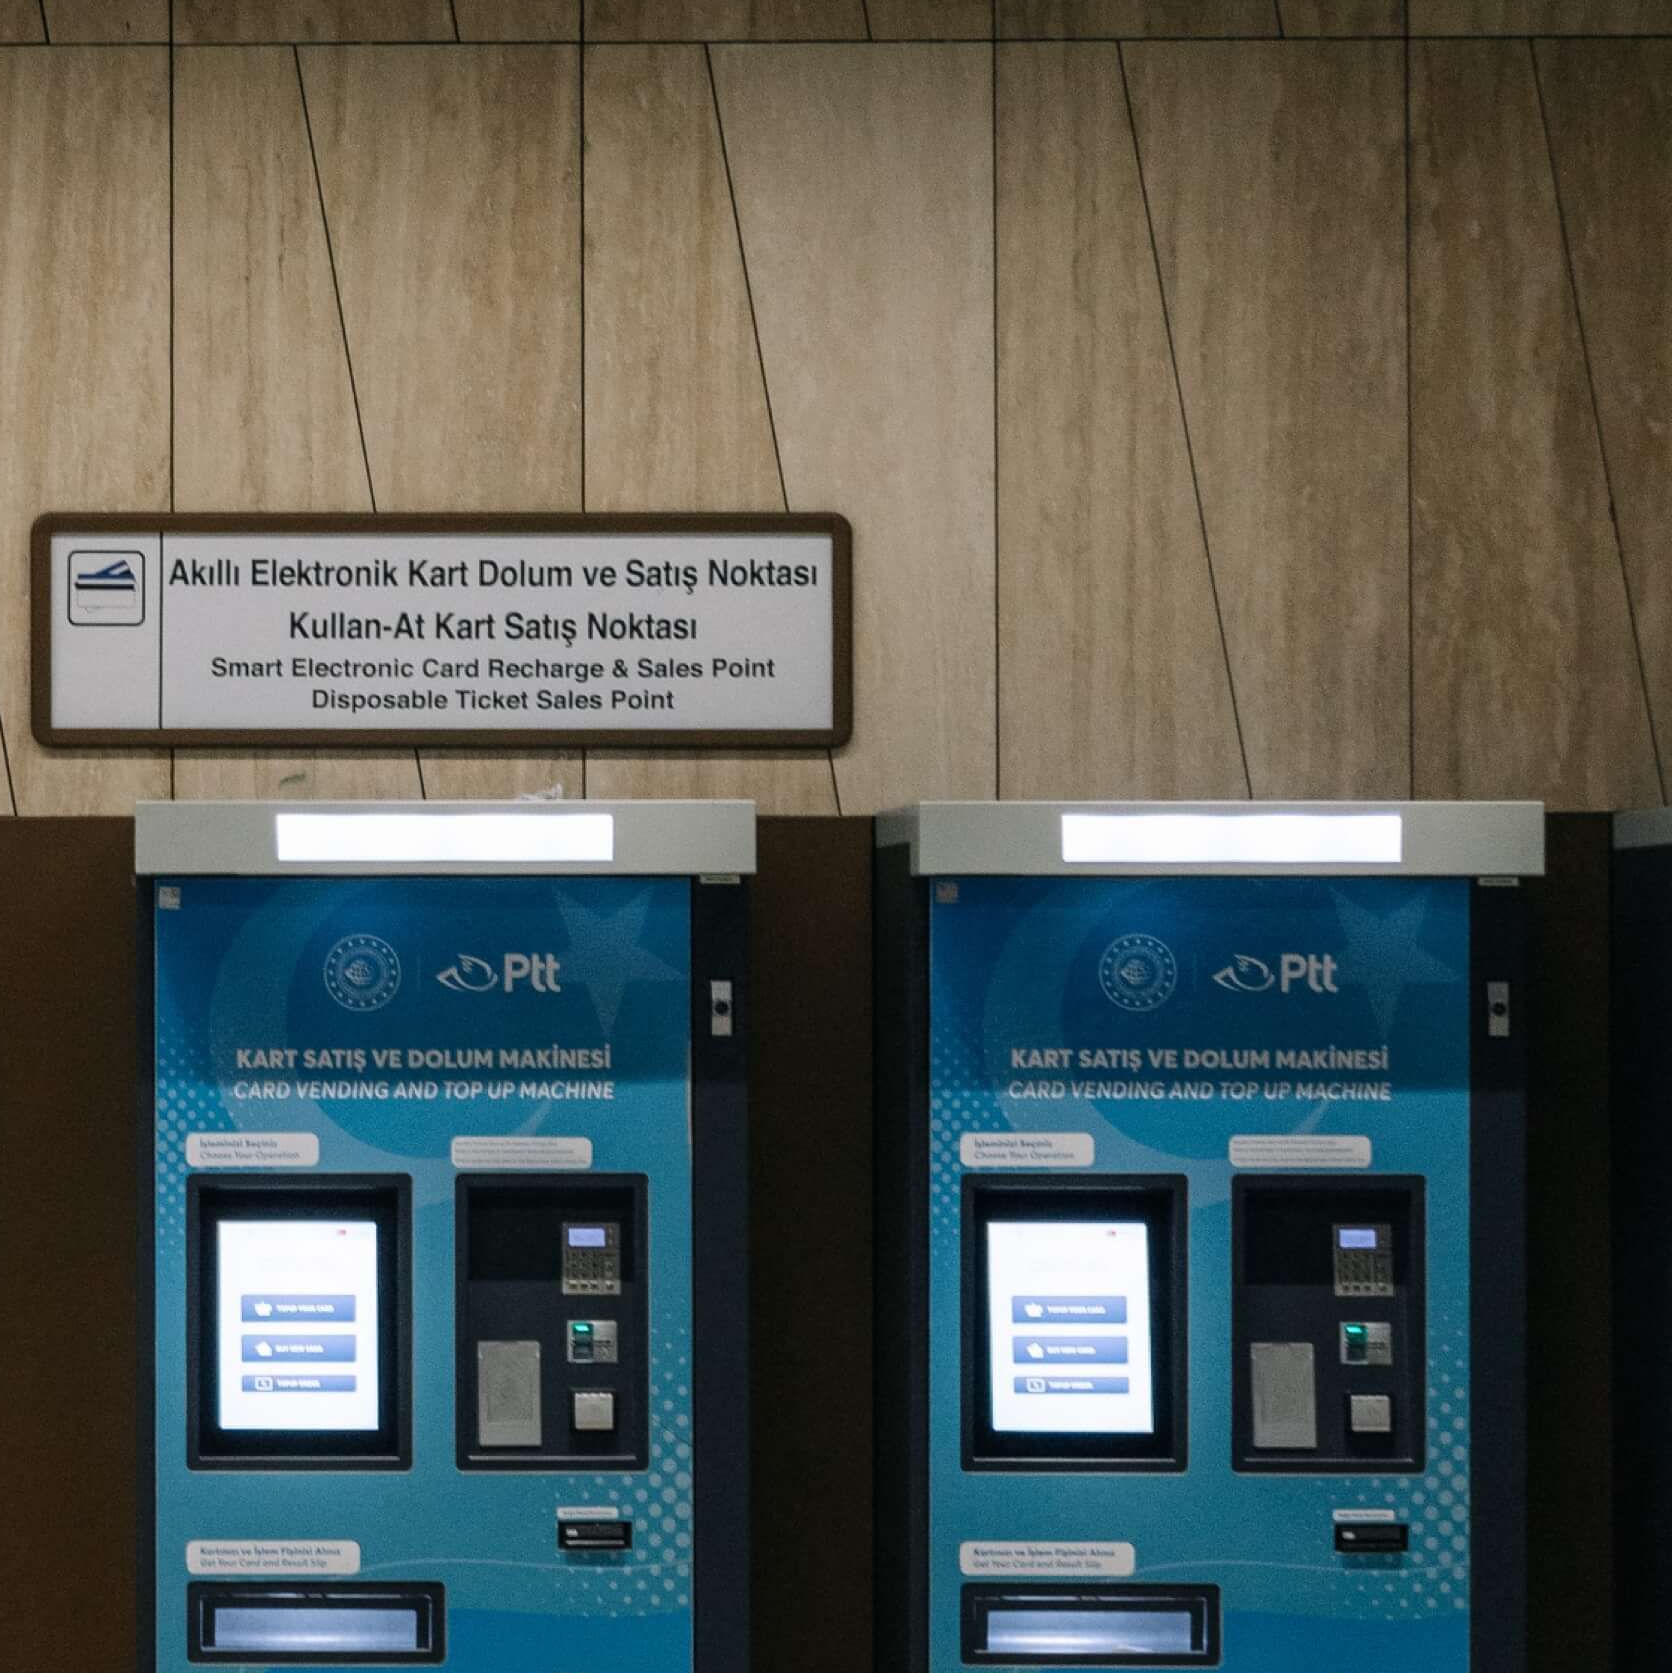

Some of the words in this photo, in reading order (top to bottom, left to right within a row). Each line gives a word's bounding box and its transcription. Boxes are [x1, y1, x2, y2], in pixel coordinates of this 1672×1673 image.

[168, 558, 241, 586] Akıllı
[250, 559, 400, 587] Elektronik
[408, 559, 470, 587] Kart
[478, 559, 573, 588] Dolum
[581, 565, 618, 588] ve
[624, 559, 699, 596] Satış
[707, 558, 817, 587] Noktası
[290, 611, 426, 640] Kullan-At
[435, 612, 497, 640] Kart
[503, 611, 578, 648] Satış
[587, 612, 697, 640] Noktası
[211, 656, 283, 678] Smart
[292, 657, 414, 678] Electronic
[422, 658, 479, 679] Card
[488, 658, 604, 684] Recharge
[612, 658, 628, 679] &
[637, 657, 703, 679] Sales
[712, 657, 775, 678] Point
[312, 689, 449, 714] Disposable
[454, 689, 529, 710] Ticket
[535, 689, 604, 710] Sales
[610, 689, 674, 710] Point
[503, 952, 561, 993] Ptt
[1280, 953, 1339, 993] Ptt
[236, 1048, 299, 1069] KART
[302, 1048, 368, 1073] SATIŞ
[370, 1049, 404, 1069] VE
[406, 1049, 495, 1069] DOLUM
[498, 1043, 611, 1069] MAKİNESİ
[1010, 1047, 1075, 1070] KART
[1077, 1048, 1144, 1073] SATIŞ
[1146, 1048, 1179, 1069] VE
[1181, 1049, 1271, 1069] DOLUM
[1274, 1044, 1389, 1070] MAKİNESİ
[233, 1081, 292, 1101] CARD
[295, 1081, 390, 1101] VENDING
[392, 1081, 439, 1101] AND
[444, 1081, 483, 1101] TOP
[487, 1082, 516, 1100] UP
[518, 1082, 615, 1101] MACHINE
[1008, 1082, 1066, 1102] CARD
[1071, 1082, 1165, 1102] VENDING
[1168, 1082, 1214, 1101] AND
[1220, 1083, 1258, 1102] TOP
[1263, 1082, 1290, 1102] UP
[1295, 1083, 1392, 1103] MACHINE
